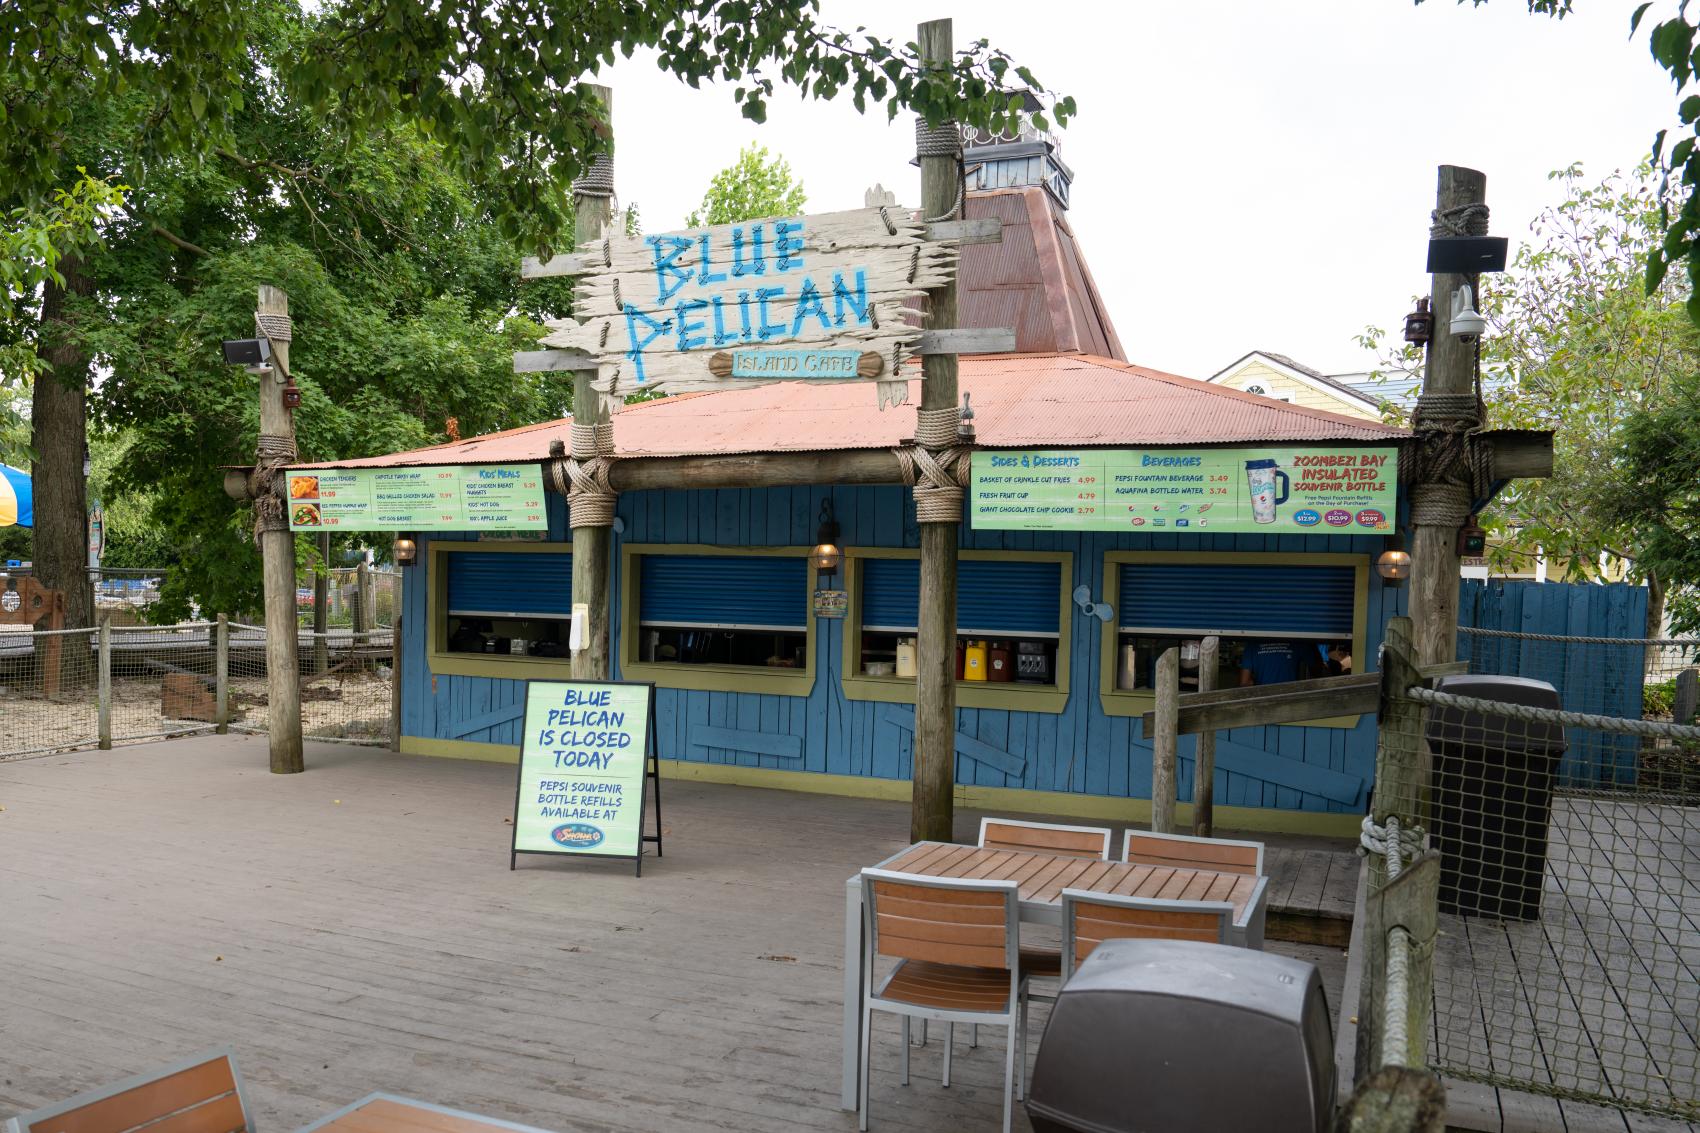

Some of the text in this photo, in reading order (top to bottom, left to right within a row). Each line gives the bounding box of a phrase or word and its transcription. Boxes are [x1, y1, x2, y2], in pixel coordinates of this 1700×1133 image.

[646, 222, 804, 304] BLUE
[624, 269, 870, 382] PELICAN
[735, 352, 800, 372] ISLAND
[991, 454, 1080, 468] SIDES & DESSERTS
[1142, 454, 1202, 467] BEVERAGES
[1293, 454, 1388, 467] ZOOMBEZI BAY
[497, 469, 521, 479] MEALS
[1301, 467, 1379, 481] INSULATED
[1115, 487, 1148, 495] AQUAFINA
[1181, 487, 1204, 495] WATER
[1294, 481, 1386, 492] SOUVENIR BOTTLE
[564, 689, 611, 707] BLUE
[547, 709, 625, 729] PELICAN
[539, 729, 631, 749] IS CLOSED
[553, 750, 614, 770] TODAY
[540, 781, 623, 795] PEPSI SOUVENIR
[538, 794, 622, 807] BOTTLE REFILLS
[541, 806, 618, 821] AVAILABLE AT
